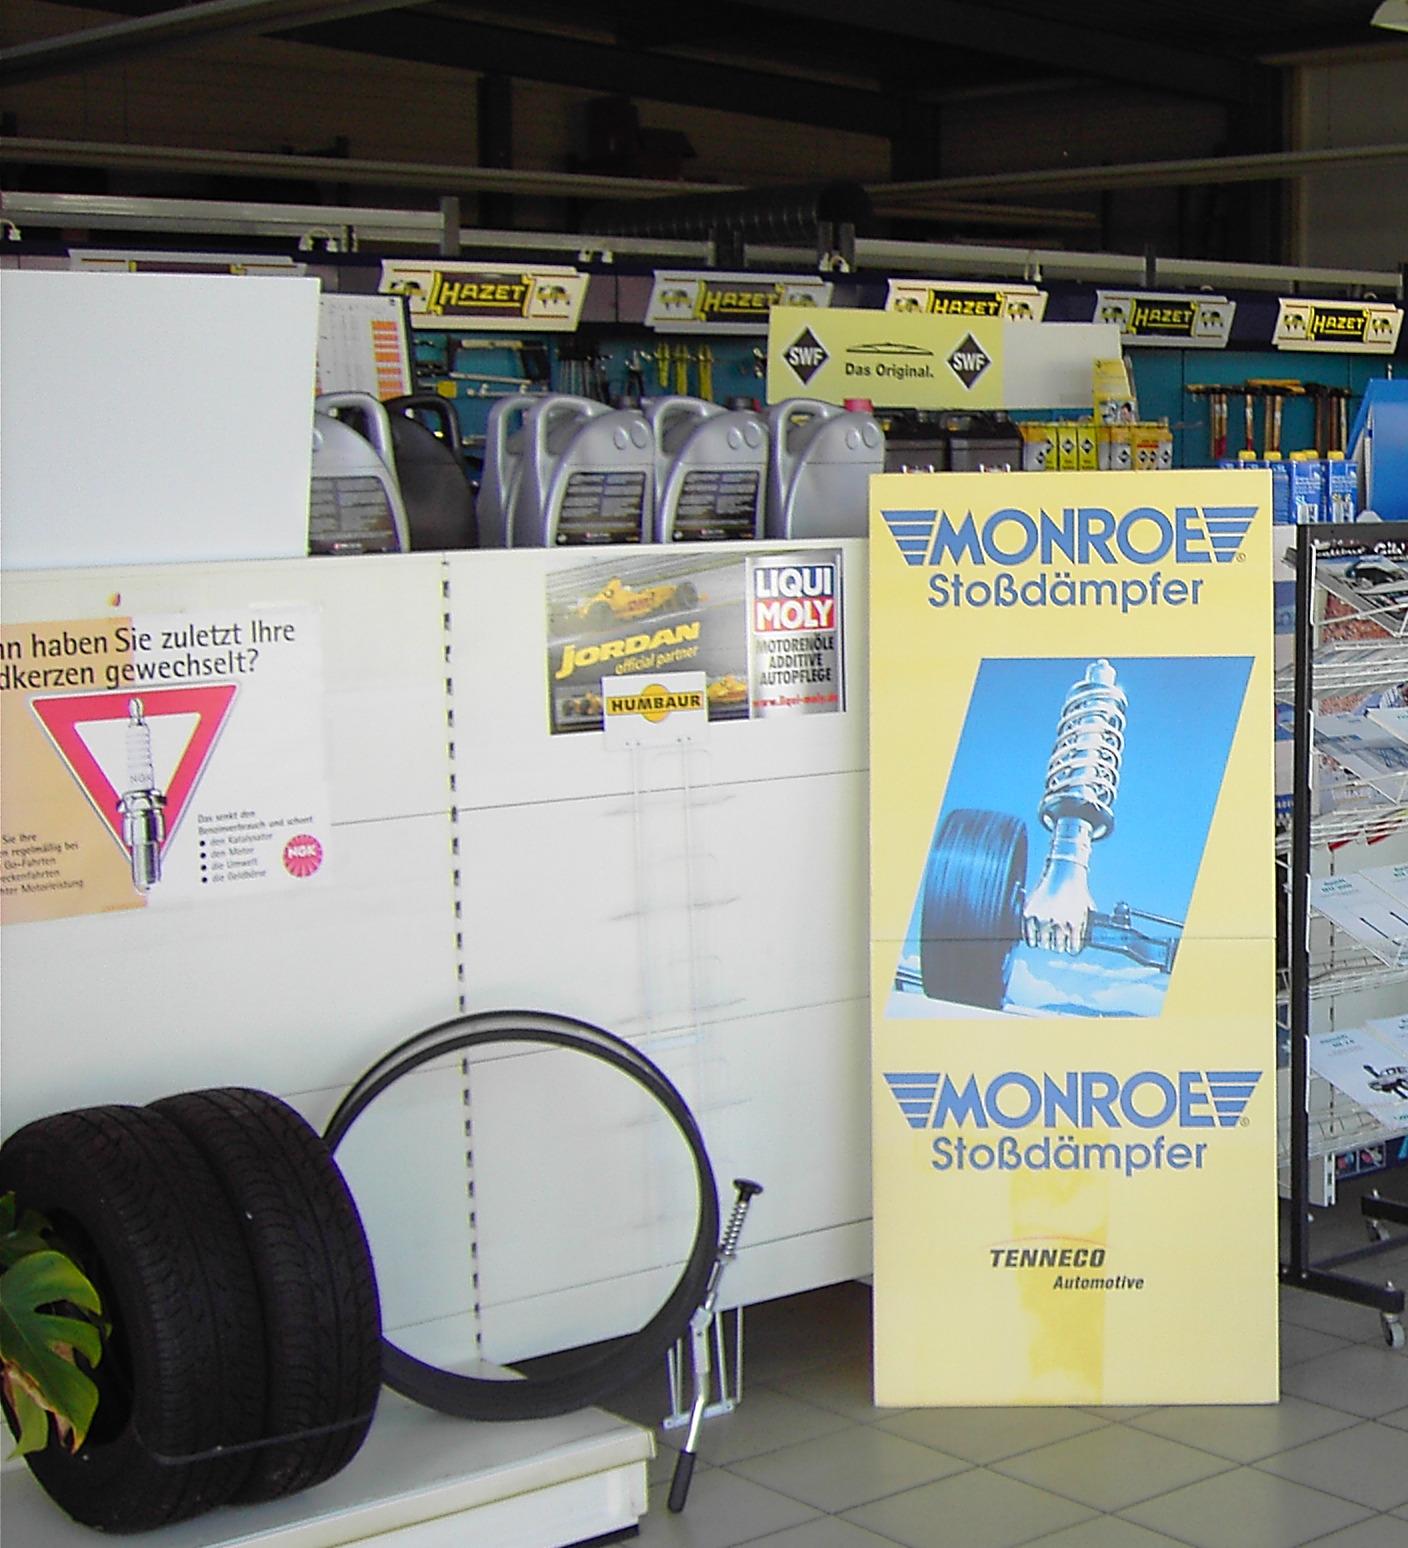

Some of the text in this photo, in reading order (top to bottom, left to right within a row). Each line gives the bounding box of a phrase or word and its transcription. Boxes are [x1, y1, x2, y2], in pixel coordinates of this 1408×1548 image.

[440, 280, 526, 308] HAZET
[704, 290, 779, 312] HAZET
[934, 298, 999, 316] HAZET
[1135, 307, 1193, 328] HAZET
[1313, 314, 1365, 334] HAZET
[788, 346, 824, 367] SWF
[952, 350, 986, 372] SWF
[845, 362, 935, 380] Das Original.
[928, 506, 1212, 566] MONROE
[756, 567, 833, 598] LIQUI
[927, 571, 1204, 614] Stoßdämpfer
[756, 600, 834, 631] MOLY
[31, 630, 109, 659] haben
[115, 626, 152, 653] Sie
[161, 622, 243, 650] zuletzt
[251, 620, 296, 643] Ihre
[105, 648, 260, 690] gewechselt?
[614, 645, 699, 676] official partner
[768, 653, 823, 669] ADDITIVE
[760, 668, 832, 686] AUTOPFLEGE
[611, 694, 702, 712] HUMBAUR
[931, 1070, 1216, 1129] MONROE
[931, 1135, 1208, 1178] Stoßdämpfer
[989, 1248, 1106, 1269] TENNECO
[1052, 1275, 1145, 1291] Automotive
